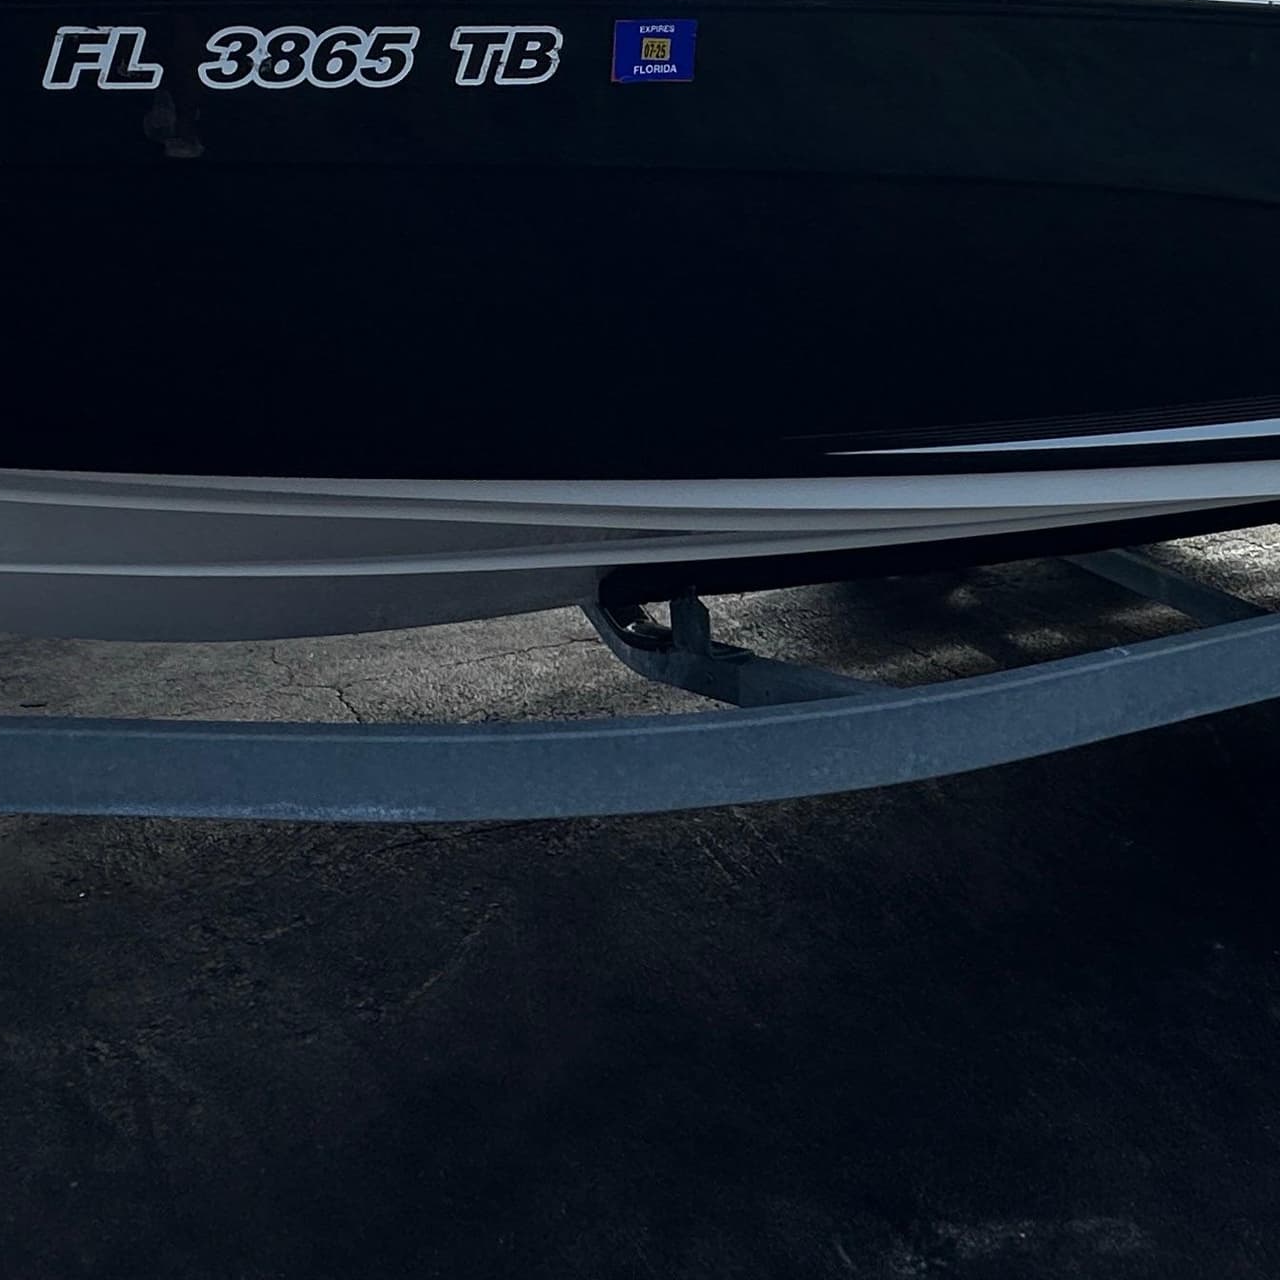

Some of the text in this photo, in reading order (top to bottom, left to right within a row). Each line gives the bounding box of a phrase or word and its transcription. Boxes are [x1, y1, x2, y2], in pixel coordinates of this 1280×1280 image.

[640, 25, 675, 33] EXPIRES
[42, 24, 563, 90] FL 3865 TB
[644, 43, 667, 59] 07-25
[633, 64, 677, 75] FLORIDA
